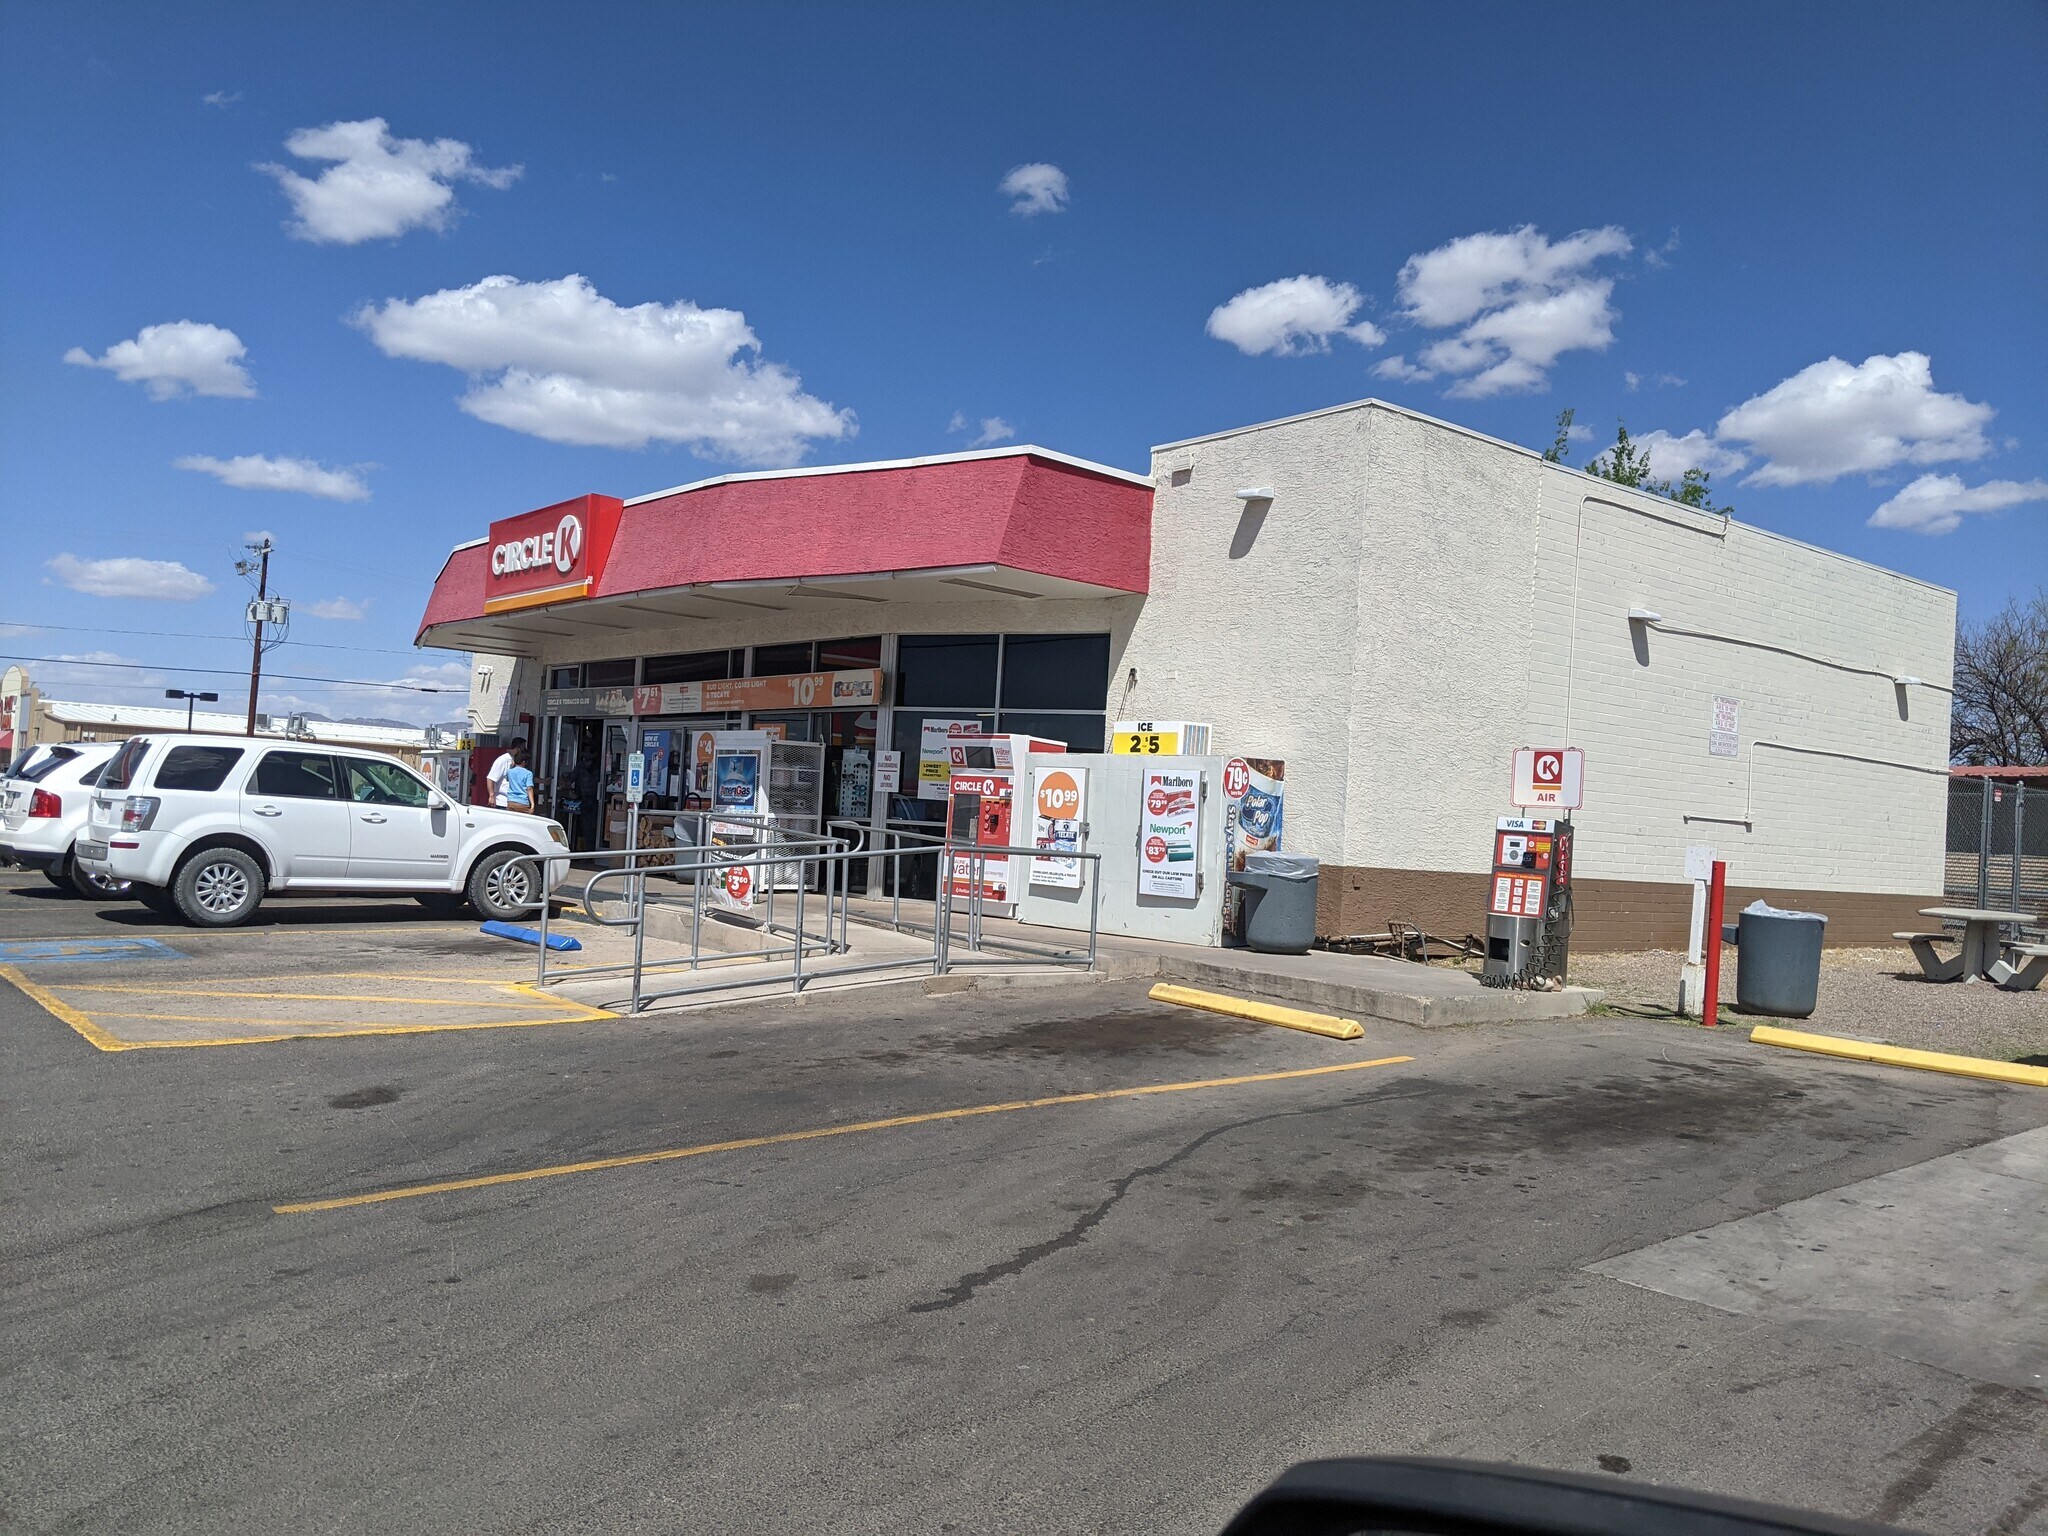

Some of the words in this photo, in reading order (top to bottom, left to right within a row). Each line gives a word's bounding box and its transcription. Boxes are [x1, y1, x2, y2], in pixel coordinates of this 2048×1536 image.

[492, 532, 554, 575] CIRCLE
[1138, 723, 1153, 731] ICE
[1130, 735, 1141, 752] 2
[954, 781, 981, 791] CIRCLE
[1163, 776, 1193, 788] Marlboro
[720, 786, 750, 797] AmeriGas
[1537, 793, 1556, 802] AIR
[1246, 795, 1267, 807] Polar
[1254, 810, 1268, 826] Pop
[1150, 823, 1186, 836] Newport
